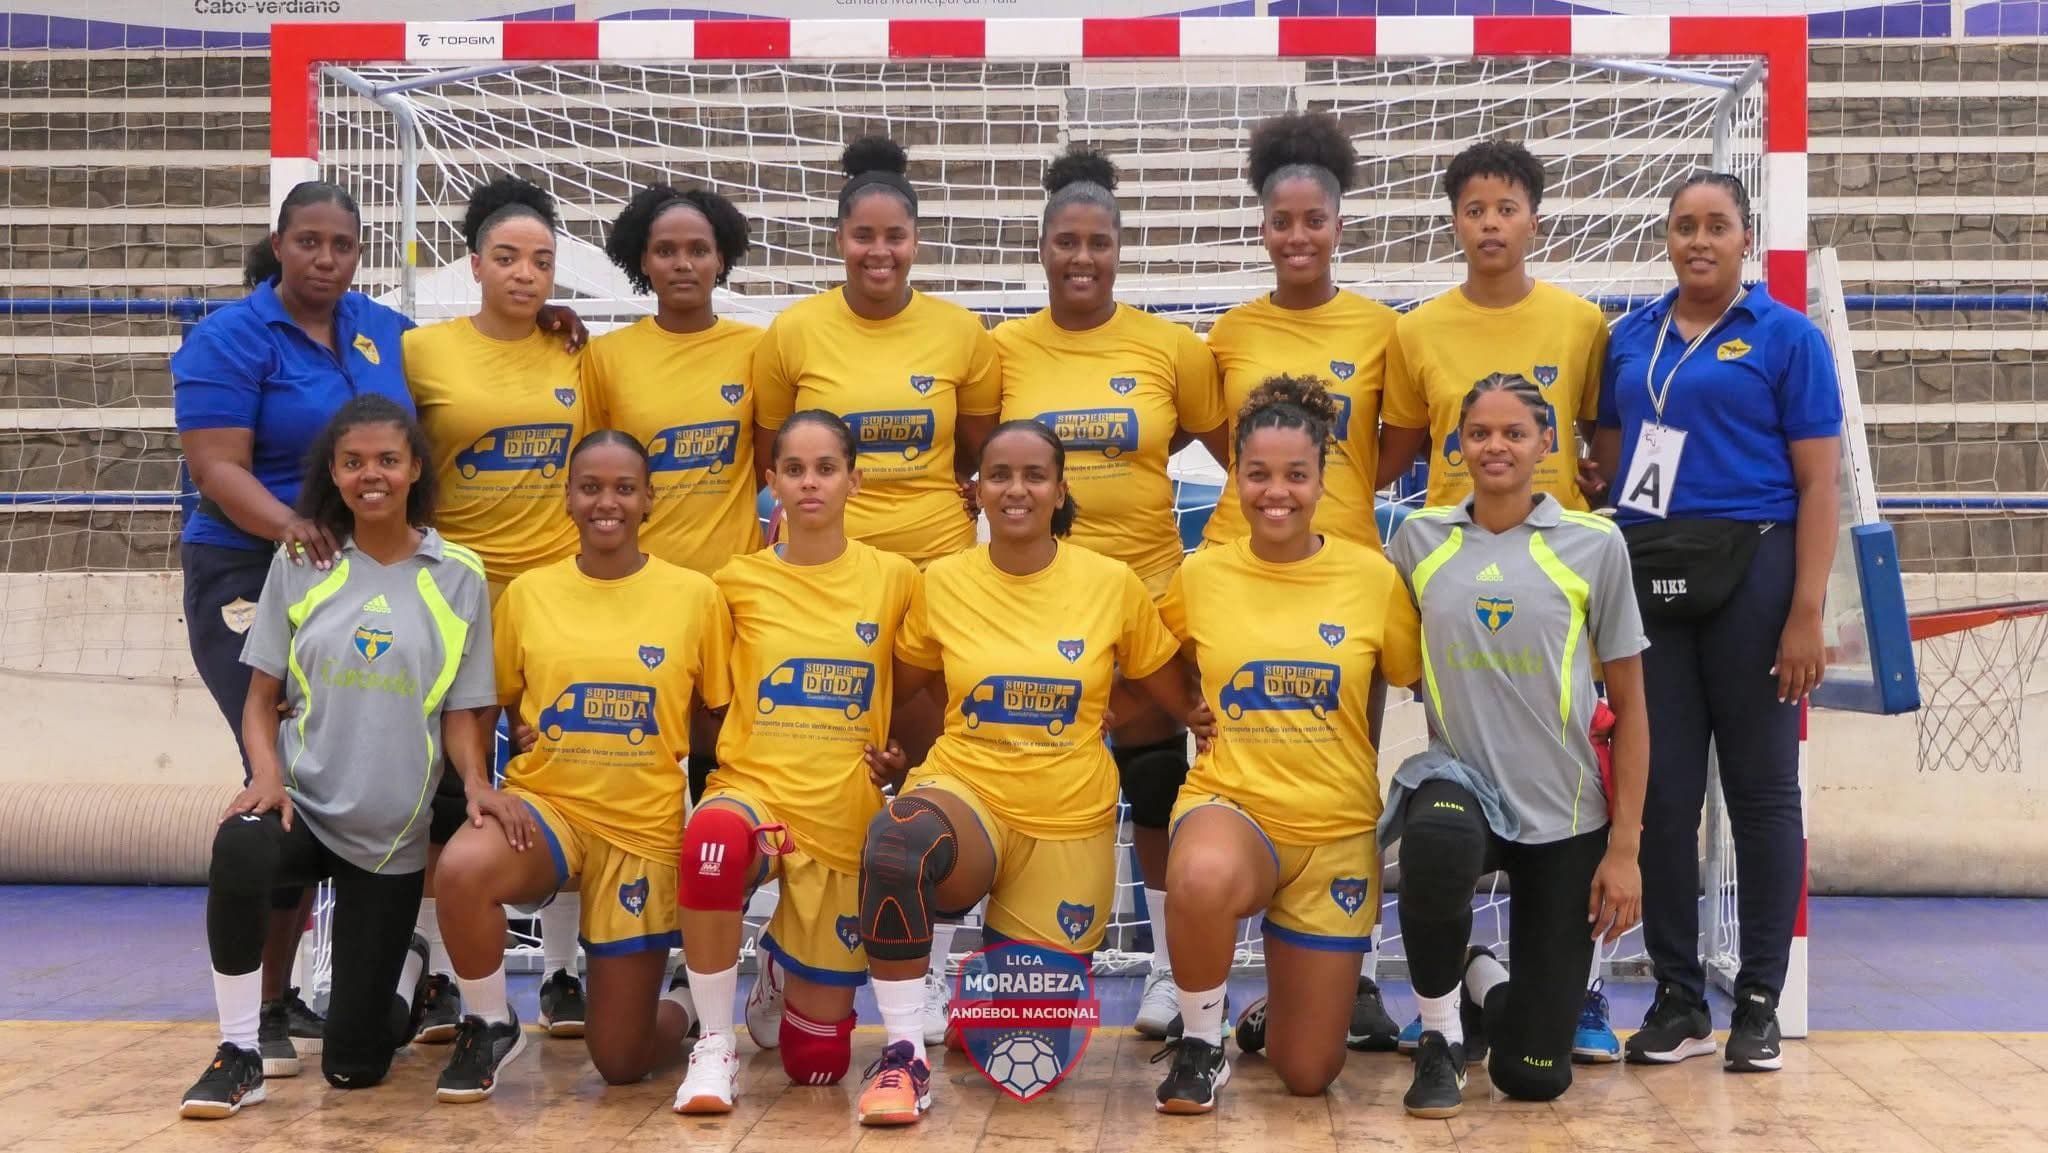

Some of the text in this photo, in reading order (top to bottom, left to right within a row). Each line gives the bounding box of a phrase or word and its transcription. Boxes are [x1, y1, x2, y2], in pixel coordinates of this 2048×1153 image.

[194, 0, 341, 14] Cabo-verdiano
[437, 36, 495, 45] TOPGIM
[862, 415, 911, 428] SUPER
[863, 425, 923, 440] DUDA
[1058, 423, 1125, 439] DUDA
[507, 438, 561, 456] DUDA
[1628, 462, 1660, 509] A
[1652, 579, 1687, 594] NIKE
[804, 663, 852, 678] SUPER
[1265, 665, 1316, 679] SUPER
[806, 675, 865, 694] DUDA
[1005, 680, 1057, 694] SUPER
[1267, 678, 1328, 696] DUDA
[586, 688, 634, 702] SUPER
[1007, 692, 1068, 710] DUDA
[587, 700, 648, 719] DUDA
[1433, 801, 1465, 812] ALLSIX
[1523, 1055, 1553, 1067] ALLSIX
